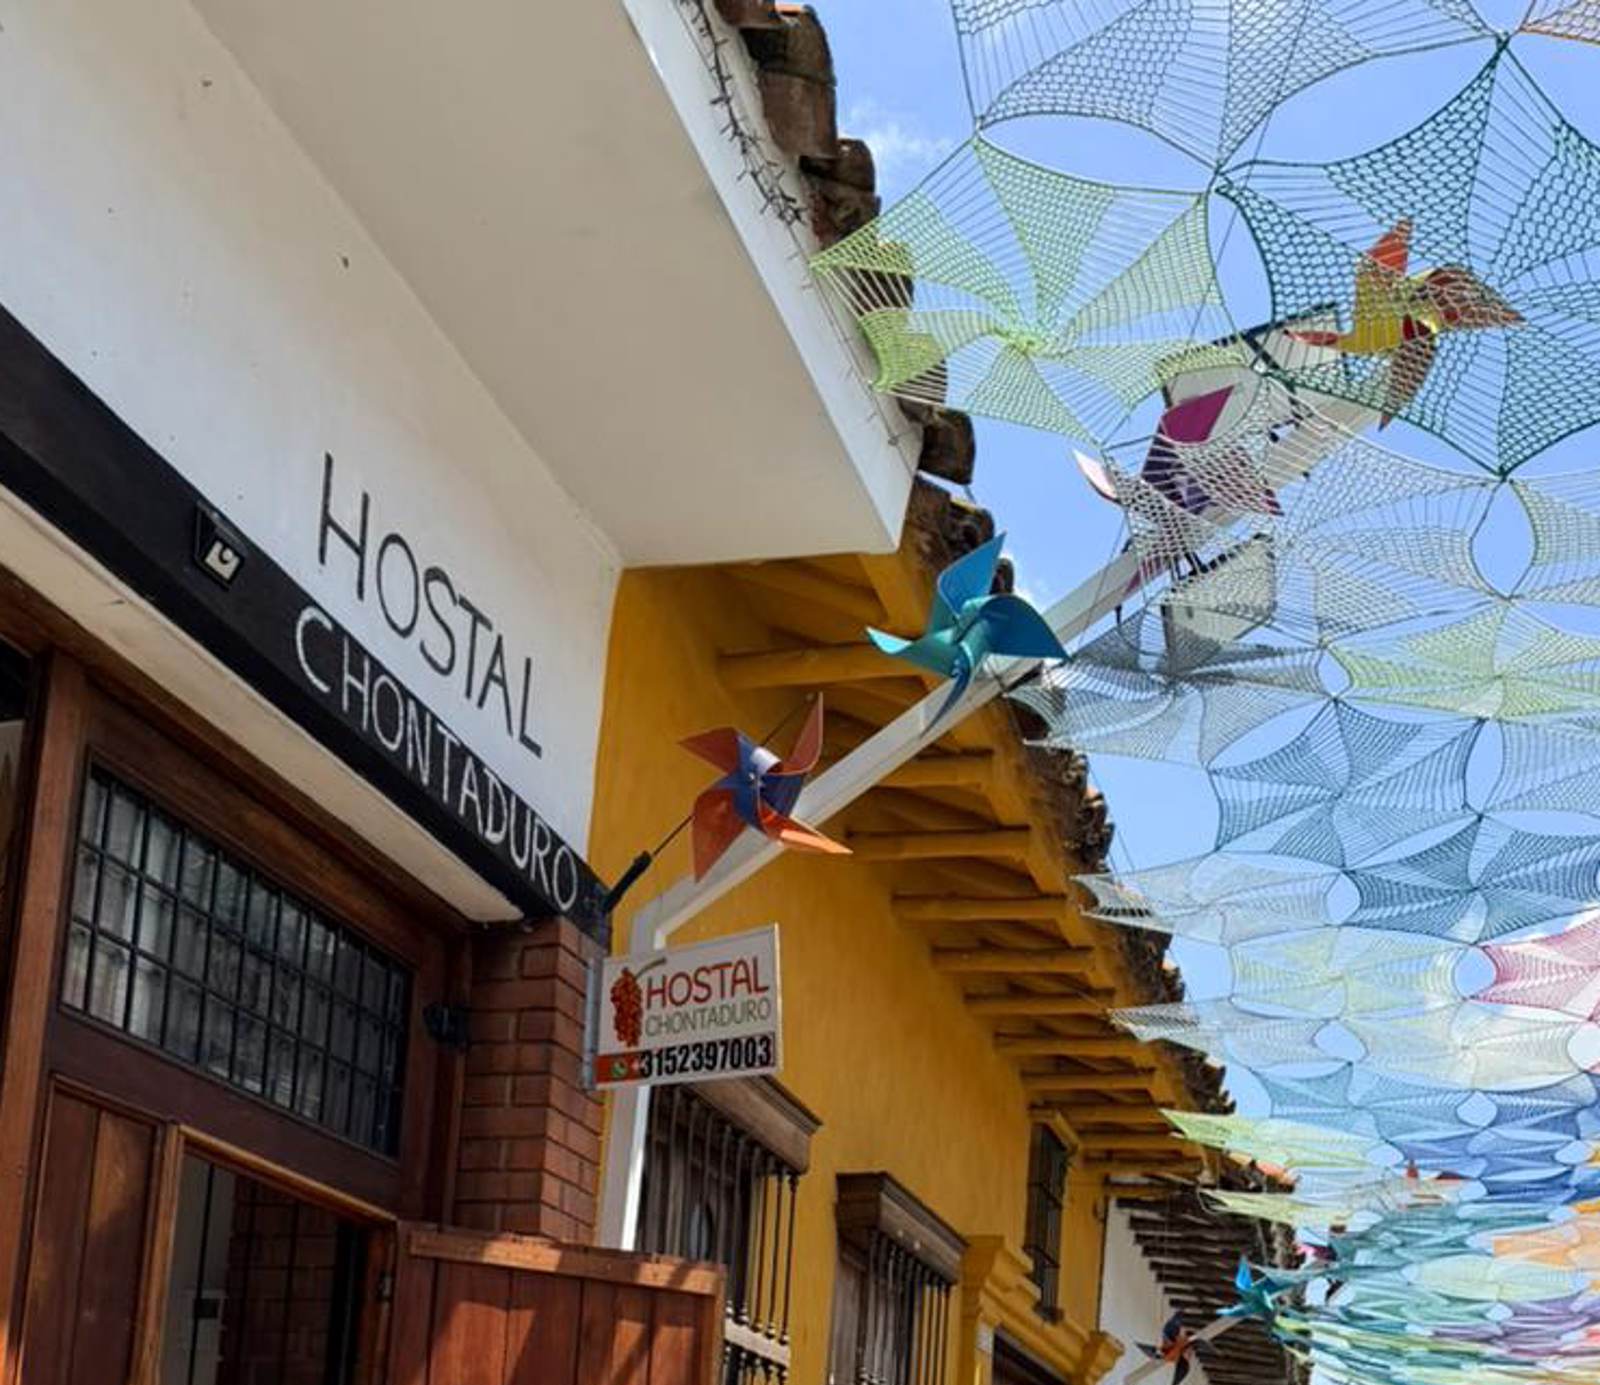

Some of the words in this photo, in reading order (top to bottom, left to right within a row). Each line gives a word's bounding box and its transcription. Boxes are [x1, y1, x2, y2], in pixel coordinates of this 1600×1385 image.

[318, 452, 542, 758] HOSTAL
[296, 606, 578, 911] CHONTADURO
[647, 956, 769, 1009] HOSTAL
[645, 997, 771, 1037] CHONTADURO
[639, 1037, 771, 1078] 3152397003
